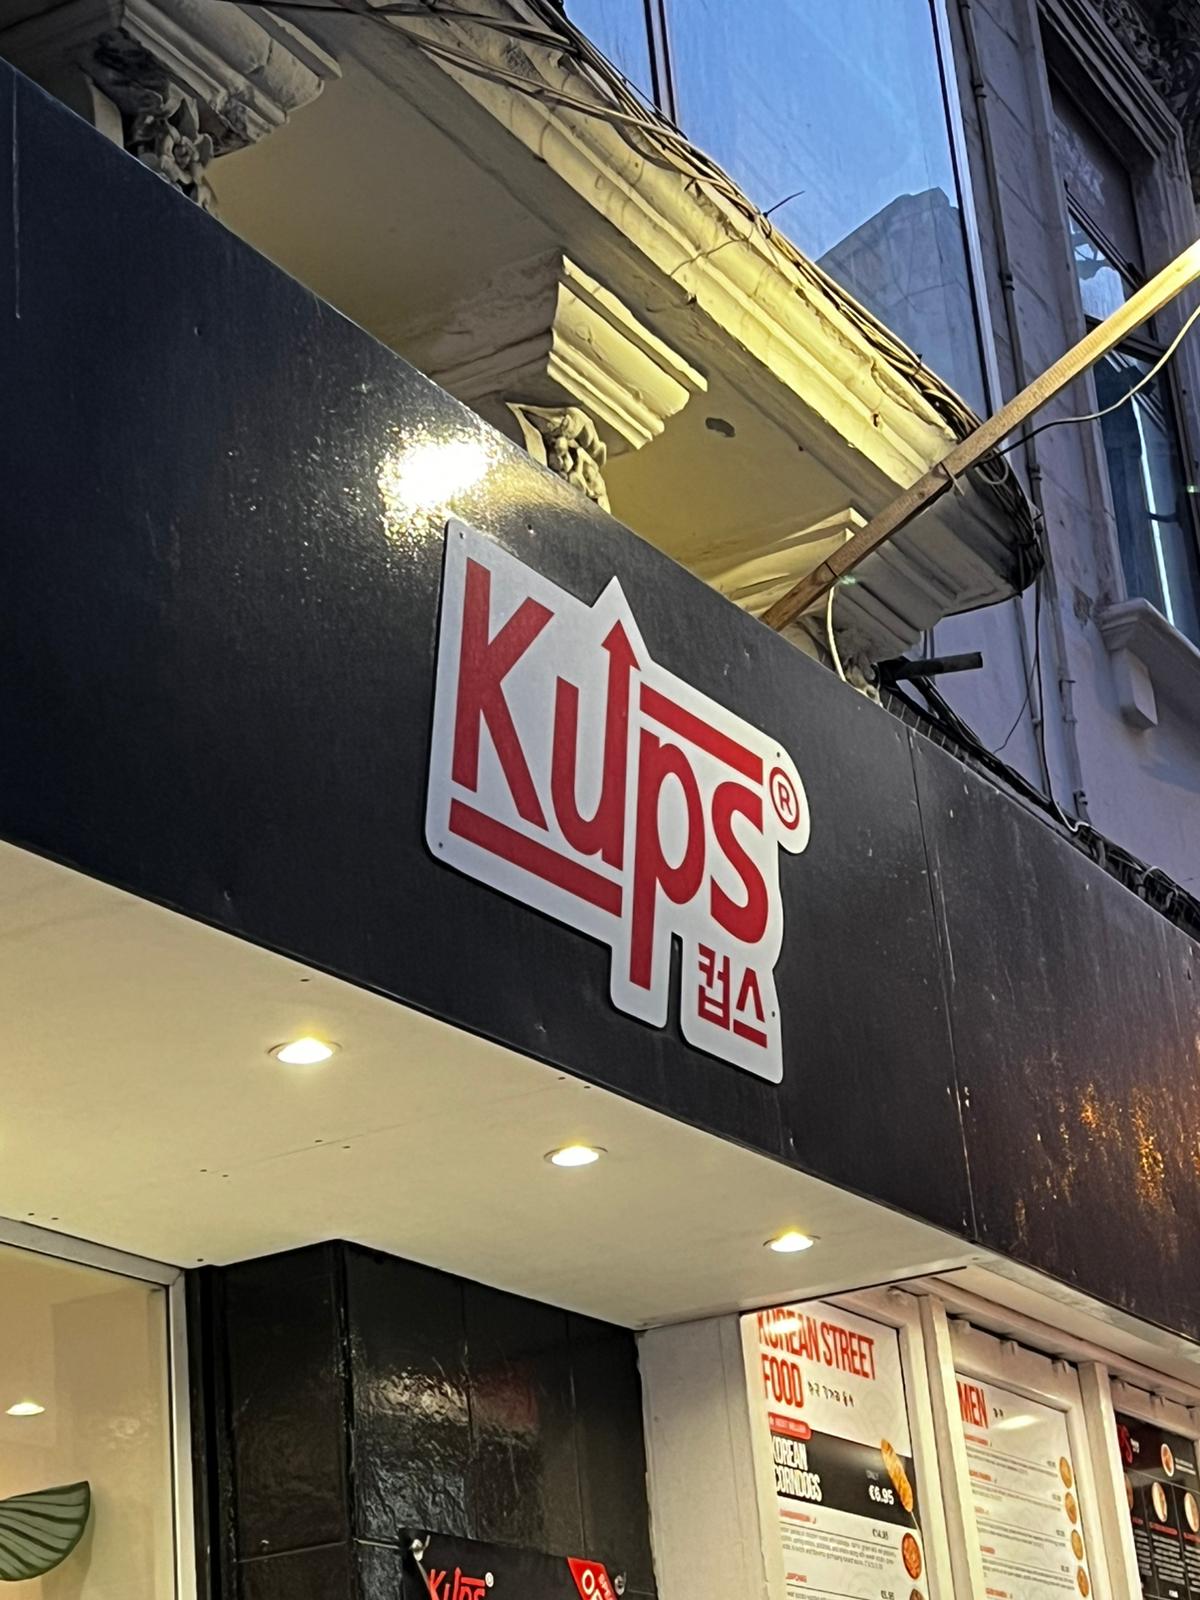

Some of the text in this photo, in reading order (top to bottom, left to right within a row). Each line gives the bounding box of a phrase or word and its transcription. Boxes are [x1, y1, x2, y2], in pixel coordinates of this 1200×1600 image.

[449, 557, 768, 990] Kups
[698, 942, 767, 1048] 컵스
[756, 1308, 876, 1381] KOREAN STREET
[761, 1353, 804, 1408] FOOD
[868, 1484, 895, 1505] €6.95
